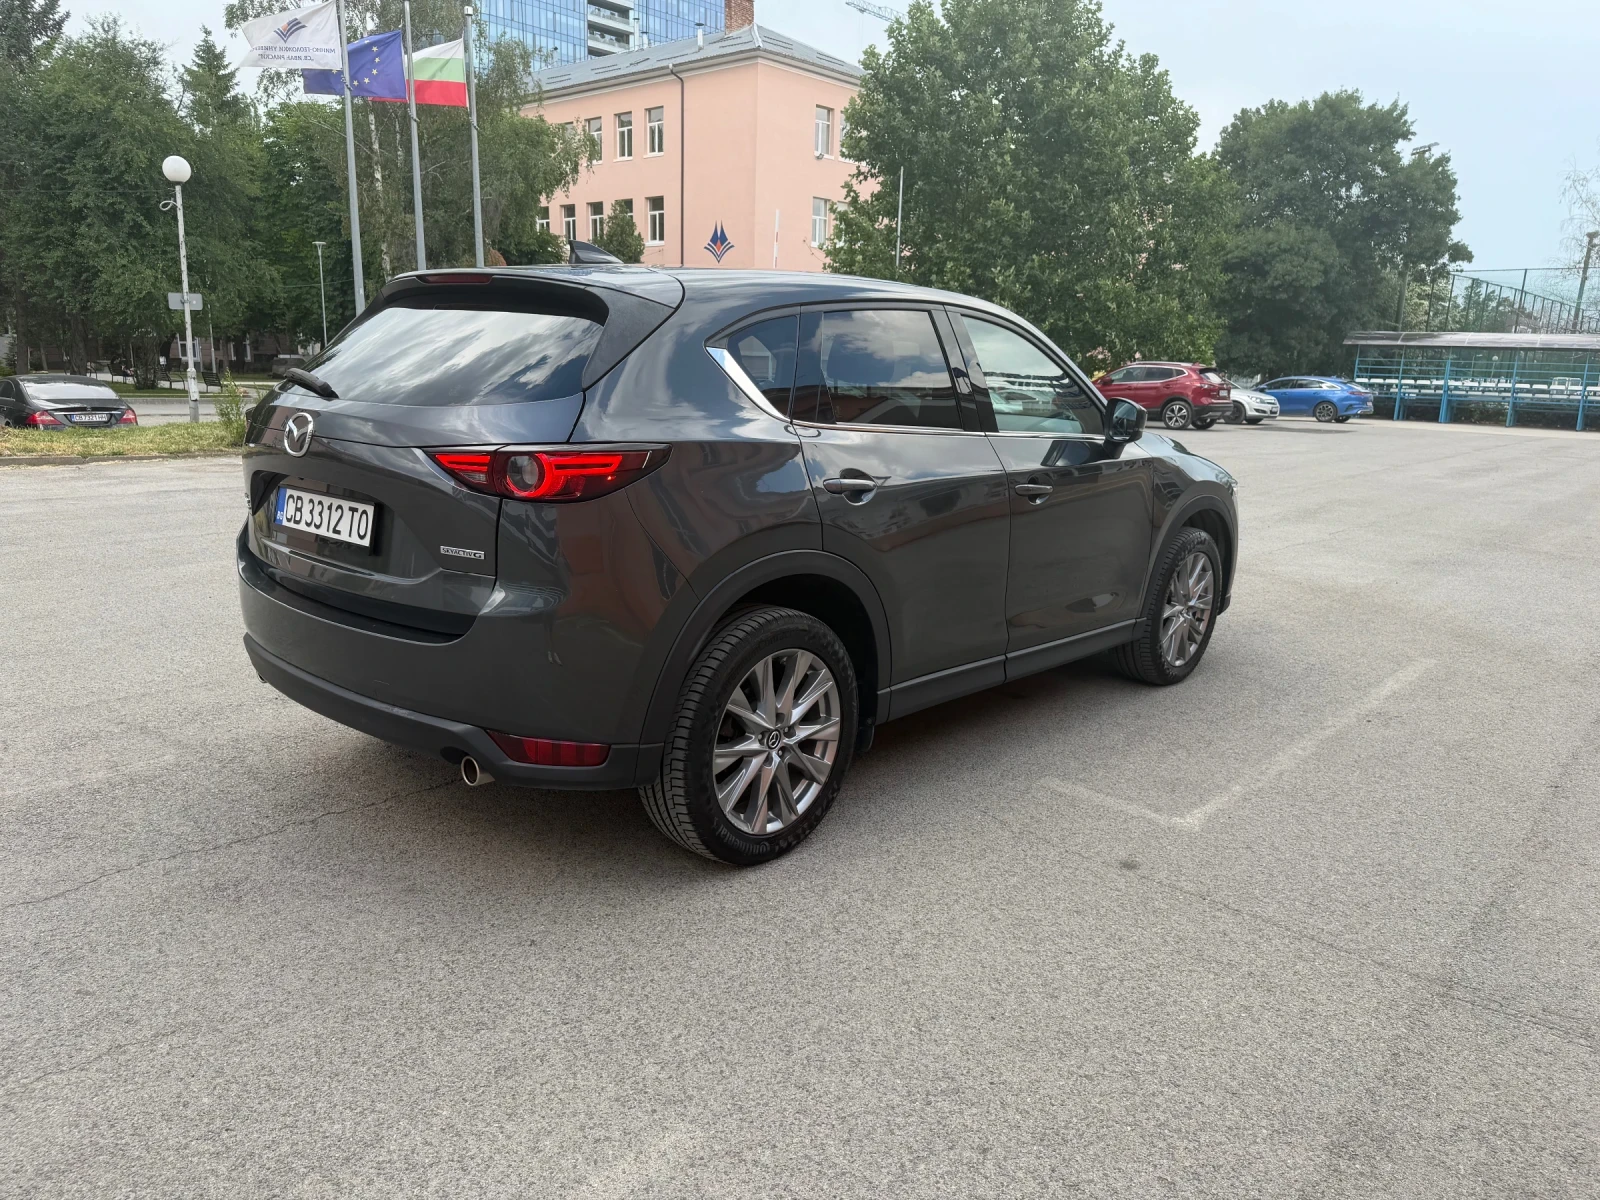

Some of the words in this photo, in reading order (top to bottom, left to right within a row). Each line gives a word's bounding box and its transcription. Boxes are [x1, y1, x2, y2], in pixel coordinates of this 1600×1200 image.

[285, 494, 303, 525] CB
[305, 498, 344, 535] 3312
[349, 506, 368, 540] TO
